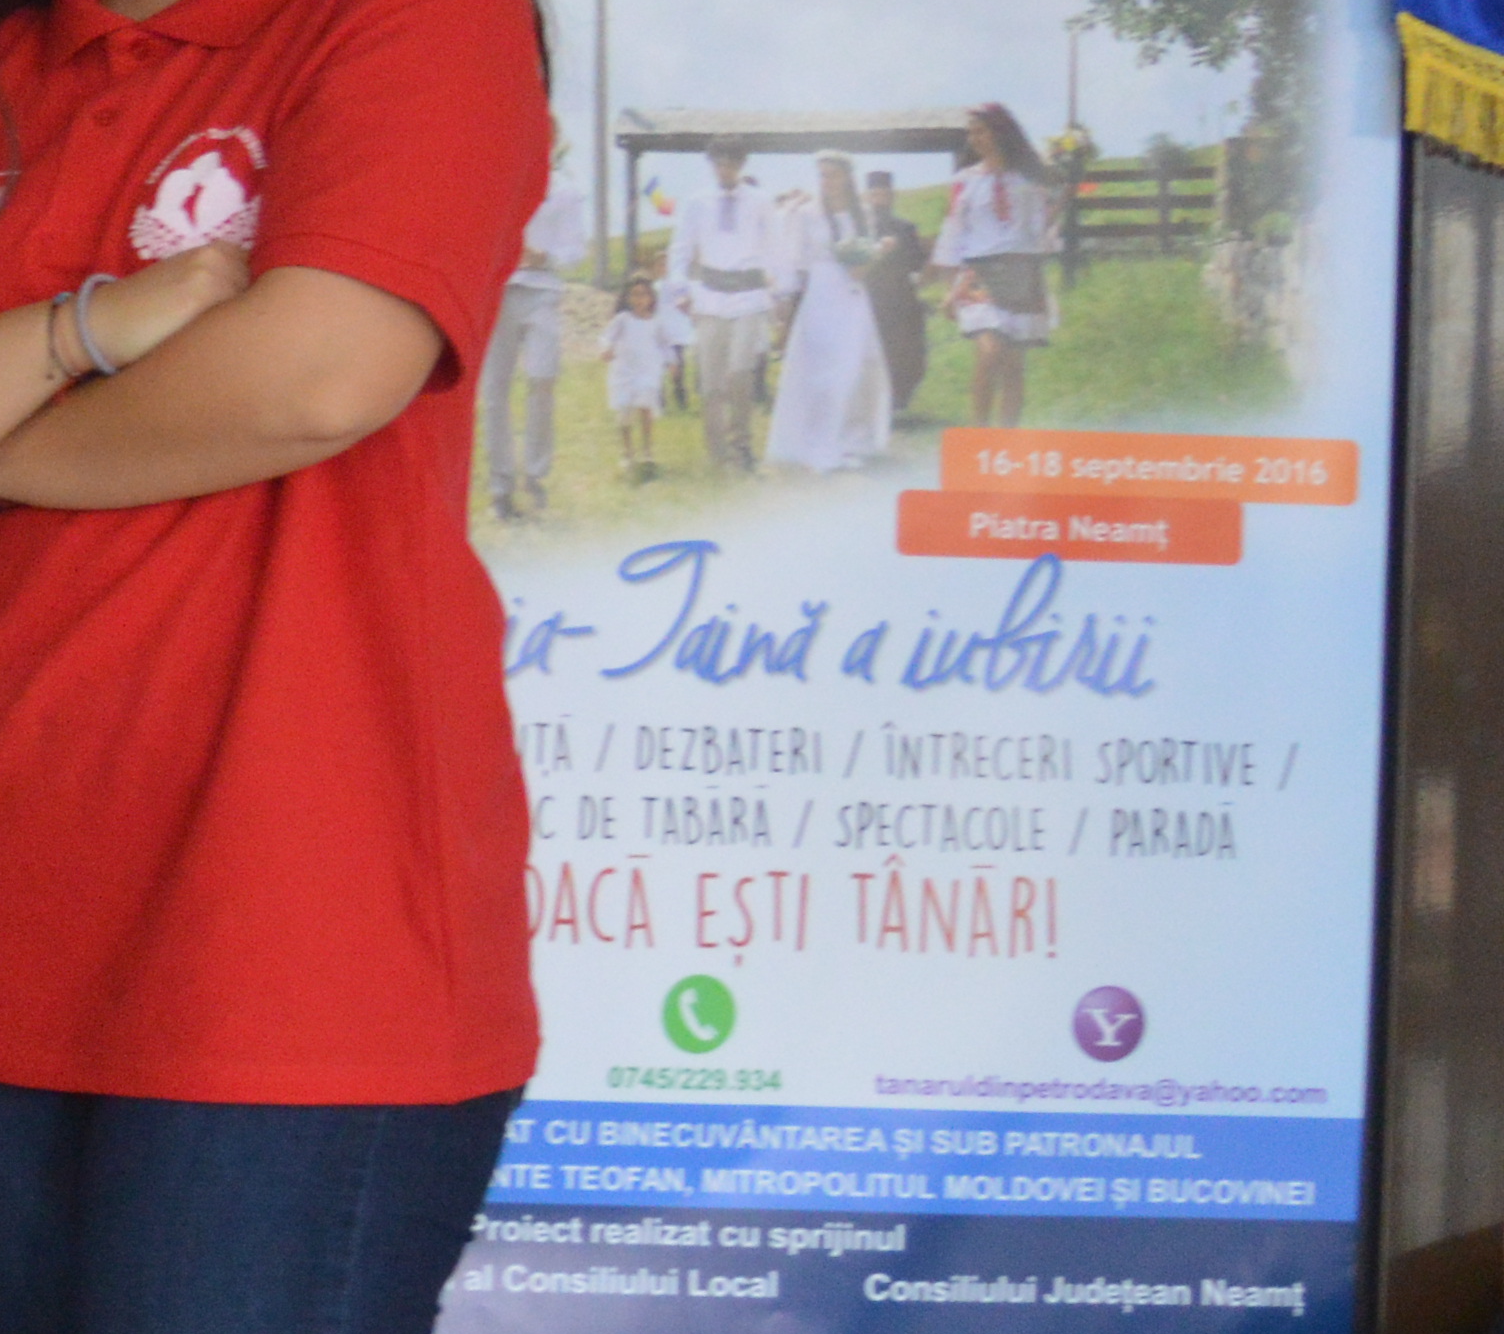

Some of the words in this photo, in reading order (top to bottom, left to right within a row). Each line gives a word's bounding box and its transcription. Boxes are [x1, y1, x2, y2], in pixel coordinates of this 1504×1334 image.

[975, 448, 1063, 479] 16-18
[1069, 451, 1245, 486] septembrie
[1253, 456, 1329, 486] 2016
[969, 511, 1061, 542] Piatra
[839, 619, 892, 685] a
[635, 723, 824, 775] DEZBATERI
[1094, 737, 1257, 787] SPORTIVE
[577, 795, 618, 841] DE
[833, 800, 1047, 854] SPECTACOLE
[543, 1119, 590, 1146] CU
[931, 1129, 998, 1156] SUB
[1004, 1129, 1204, 1160] PATRONAJUL
[701, 1167, 938, 1200] MITROPOLITUL
[944, 1173, 1106, 1202] MOLDOVEI
[1147, 1178, 1317, 1206] BUCOVINEI
[589, 1216, 712, 1248] realizat
[718, 1224, 761, 1250] cu
[767, 1222, 907, 1258] sprijinul
[463, 1264, 495, 1293] al
[501, 1264, 680, 1297] Consiliului
[688, 1269, 780, 1299] Local
[862, 1272, 1038, 1305] Consiliului
